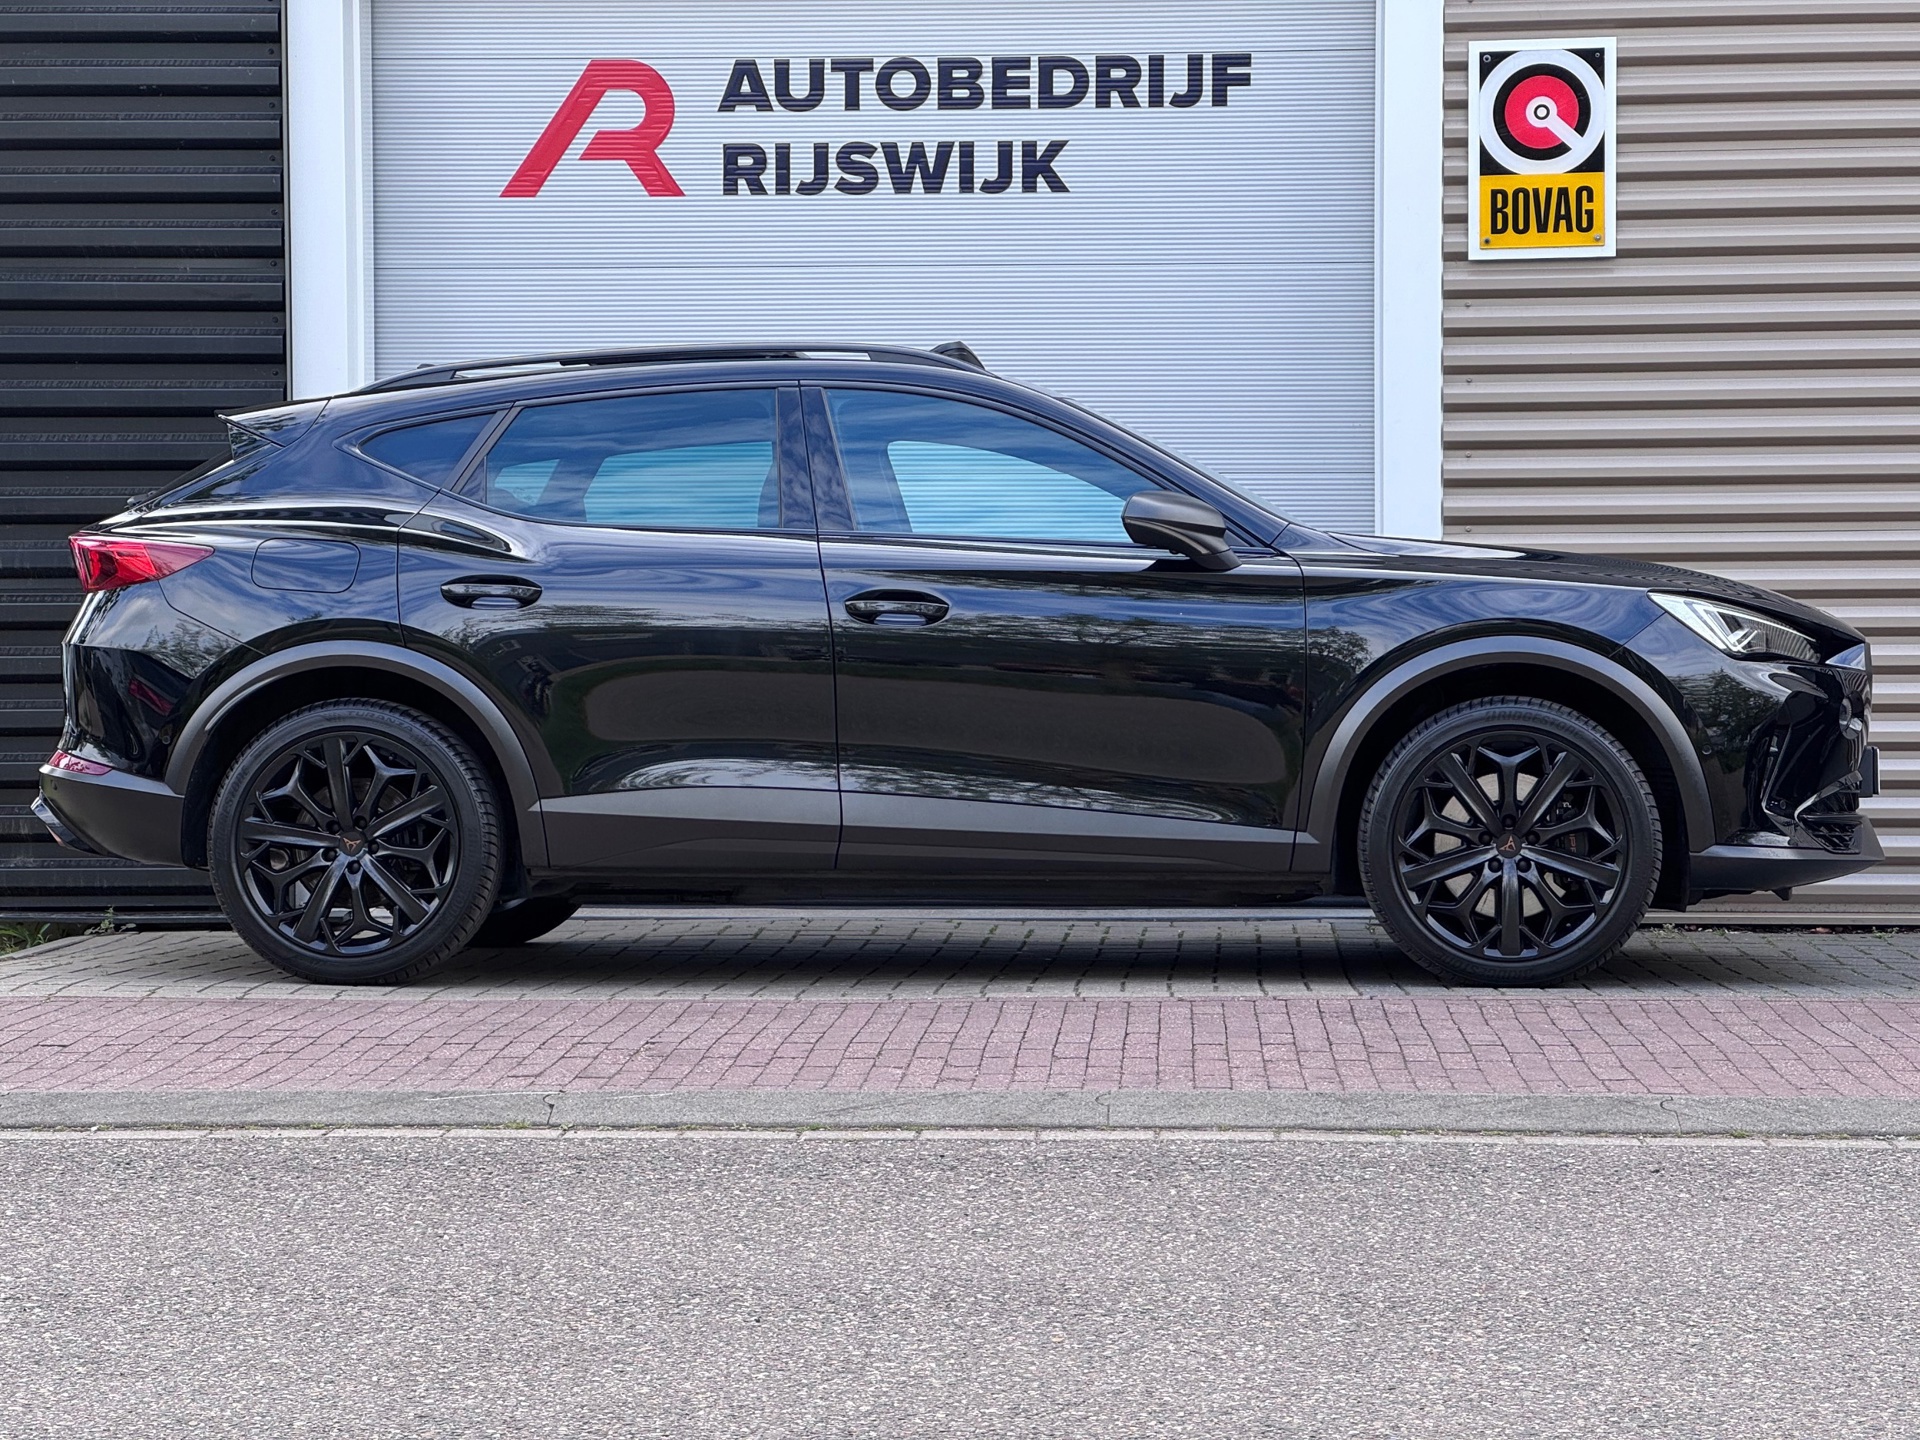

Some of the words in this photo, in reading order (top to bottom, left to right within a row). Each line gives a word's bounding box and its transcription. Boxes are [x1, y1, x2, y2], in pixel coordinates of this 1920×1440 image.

[718, 53, 1252, 112] AUTOBEDRIJF
[722, 141, 1070, 196] RIJSWIJK
[1490, 185, 1594, 235] BOVAG
[348, 710, 413, 732] TURANZA
[1485, 710, 1585, 739] BRIDGESTONE
